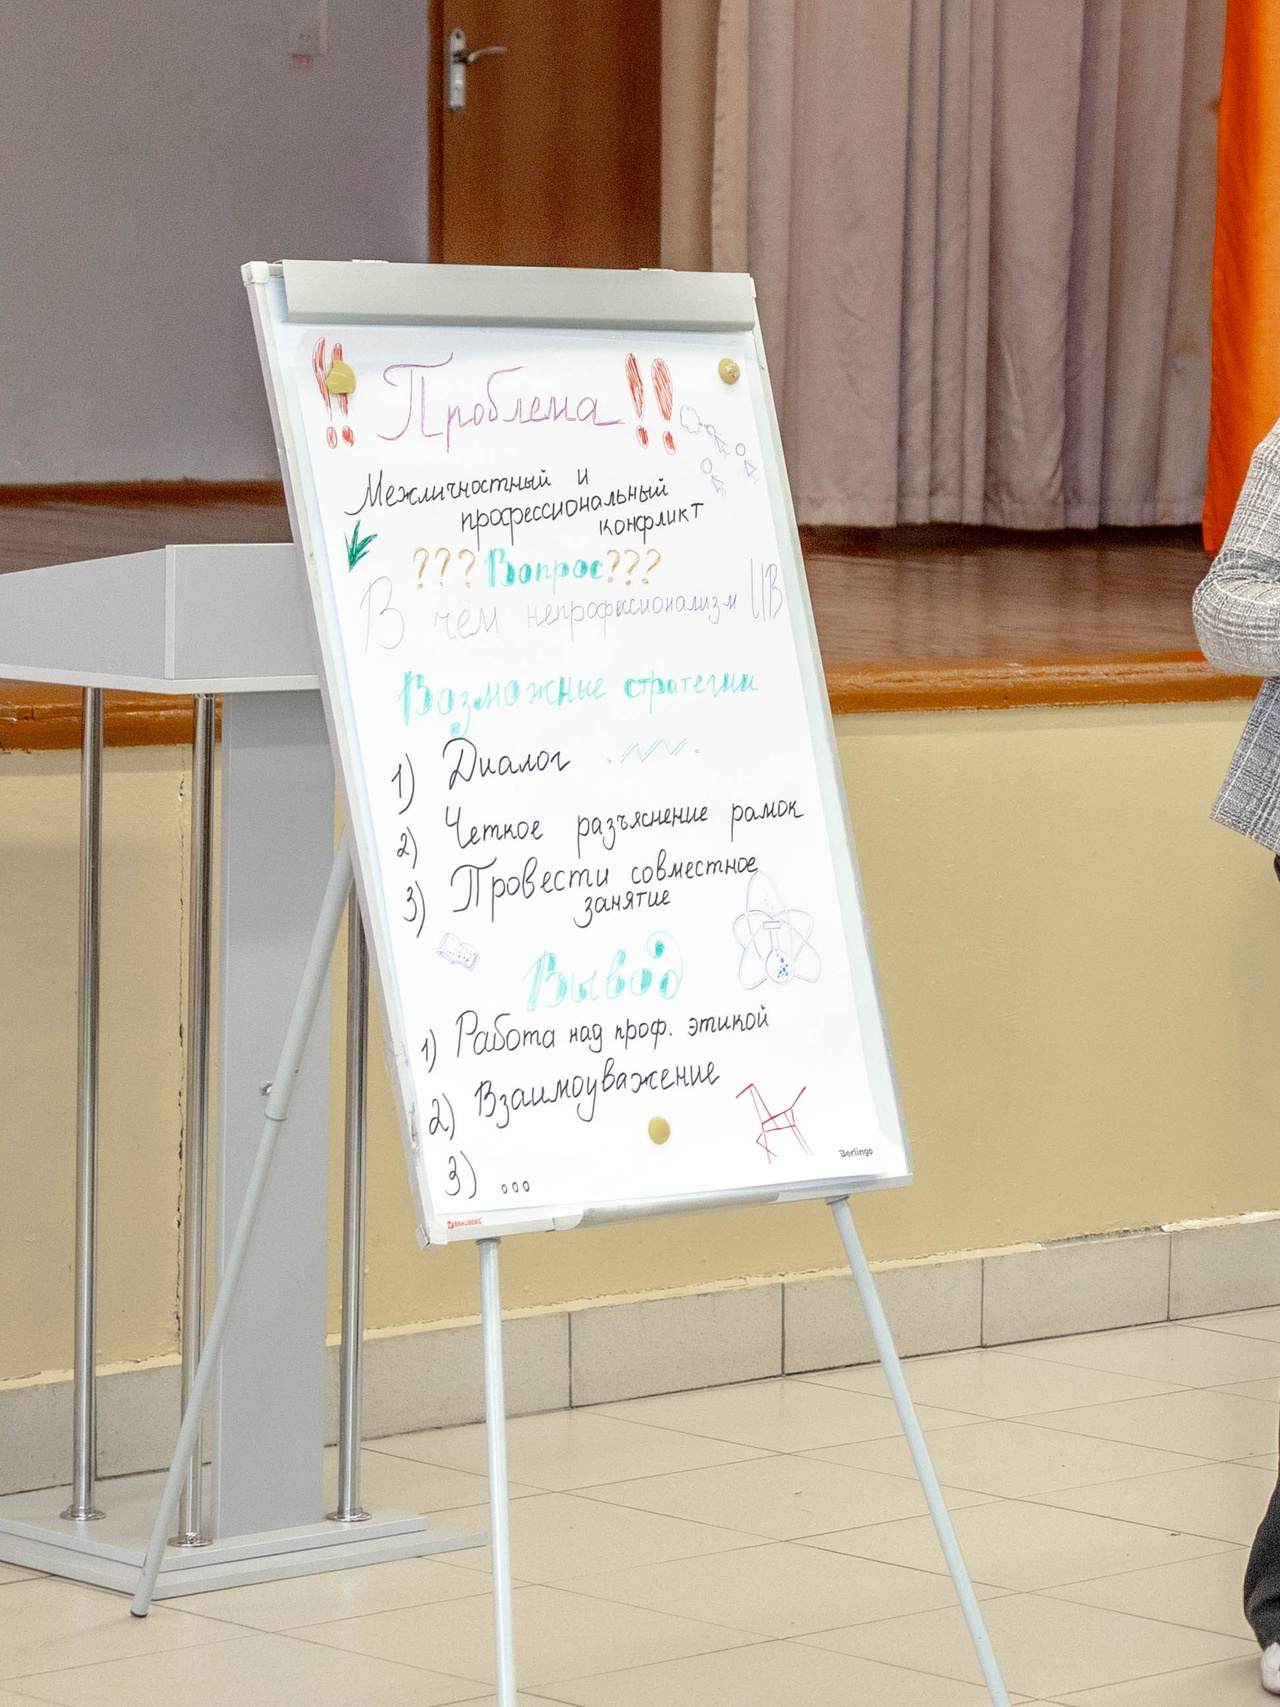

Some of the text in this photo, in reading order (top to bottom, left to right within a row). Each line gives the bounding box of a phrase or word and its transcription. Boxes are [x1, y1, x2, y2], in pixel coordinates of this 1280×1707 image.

[377, 352, 625, 453] Проблема
[344, 468, 588, 515] Межличностный и
[461, 478, 669, 552] профессиональный
[599, 502, 704, 545] конфликт
[360, 576, 404, 654] В
[398, 670, 759, 738] Возможные стратегии
[391, 737, 571, 815] 1) Диалог
[396, 800, 804, 869] 2) Четкое разъяснение рамок
[403, 849, 758, 938] 3) Провести совместное
[573, 889, 671, 928] занятие
[522, 931, 684, 1011] Вывод
[421, 1004, 769, 1073] 1) Работа над проф. этикой
[429, 1057, 720, 1140] 2) Взаимоуважение
[445, 1151, 477, 1199] 3)
[838, 1147, 873, 1157] Berlingo
